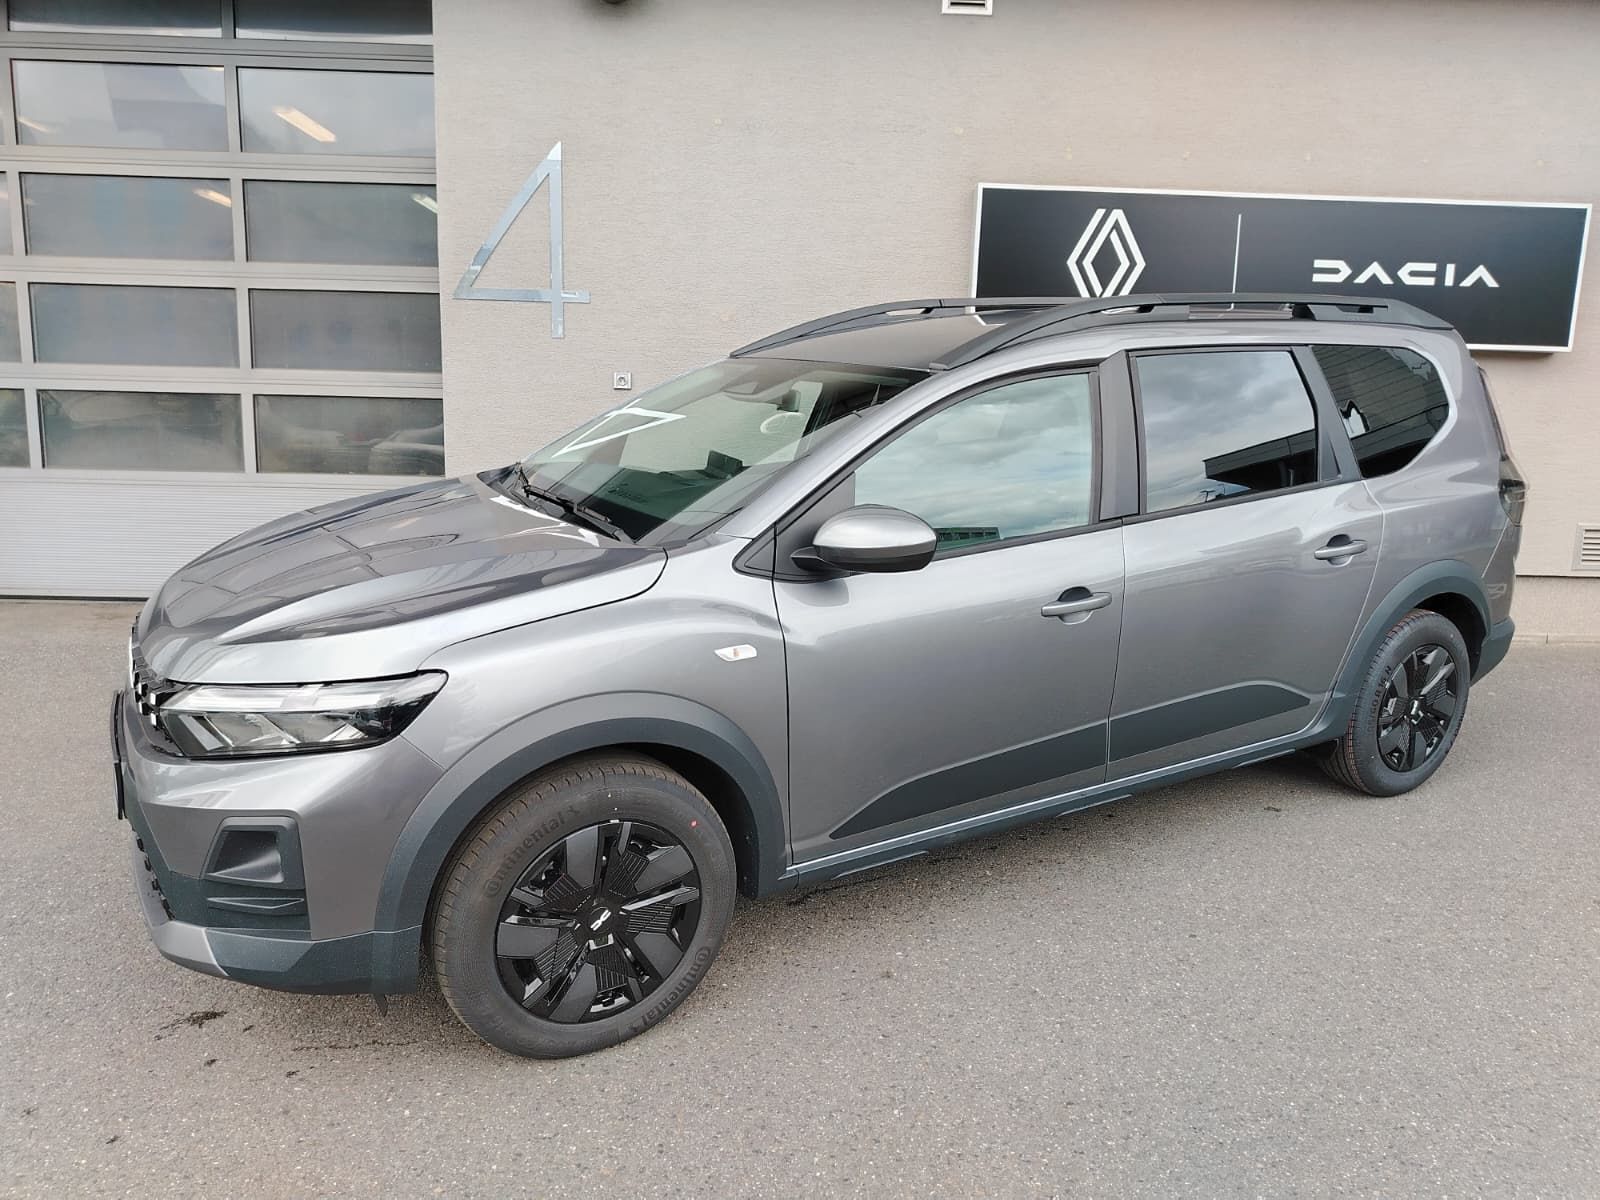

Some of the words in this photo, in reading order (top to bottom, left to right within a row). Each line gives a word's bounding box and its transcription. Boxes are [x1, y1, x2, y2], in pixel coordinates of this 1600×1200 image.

[453, 141, 591, 338] 4
[1311, 258, 1500, 288] DACIA
[484, 810, 566, 898] Continental
[641, 946, 711, 1026] Continental
